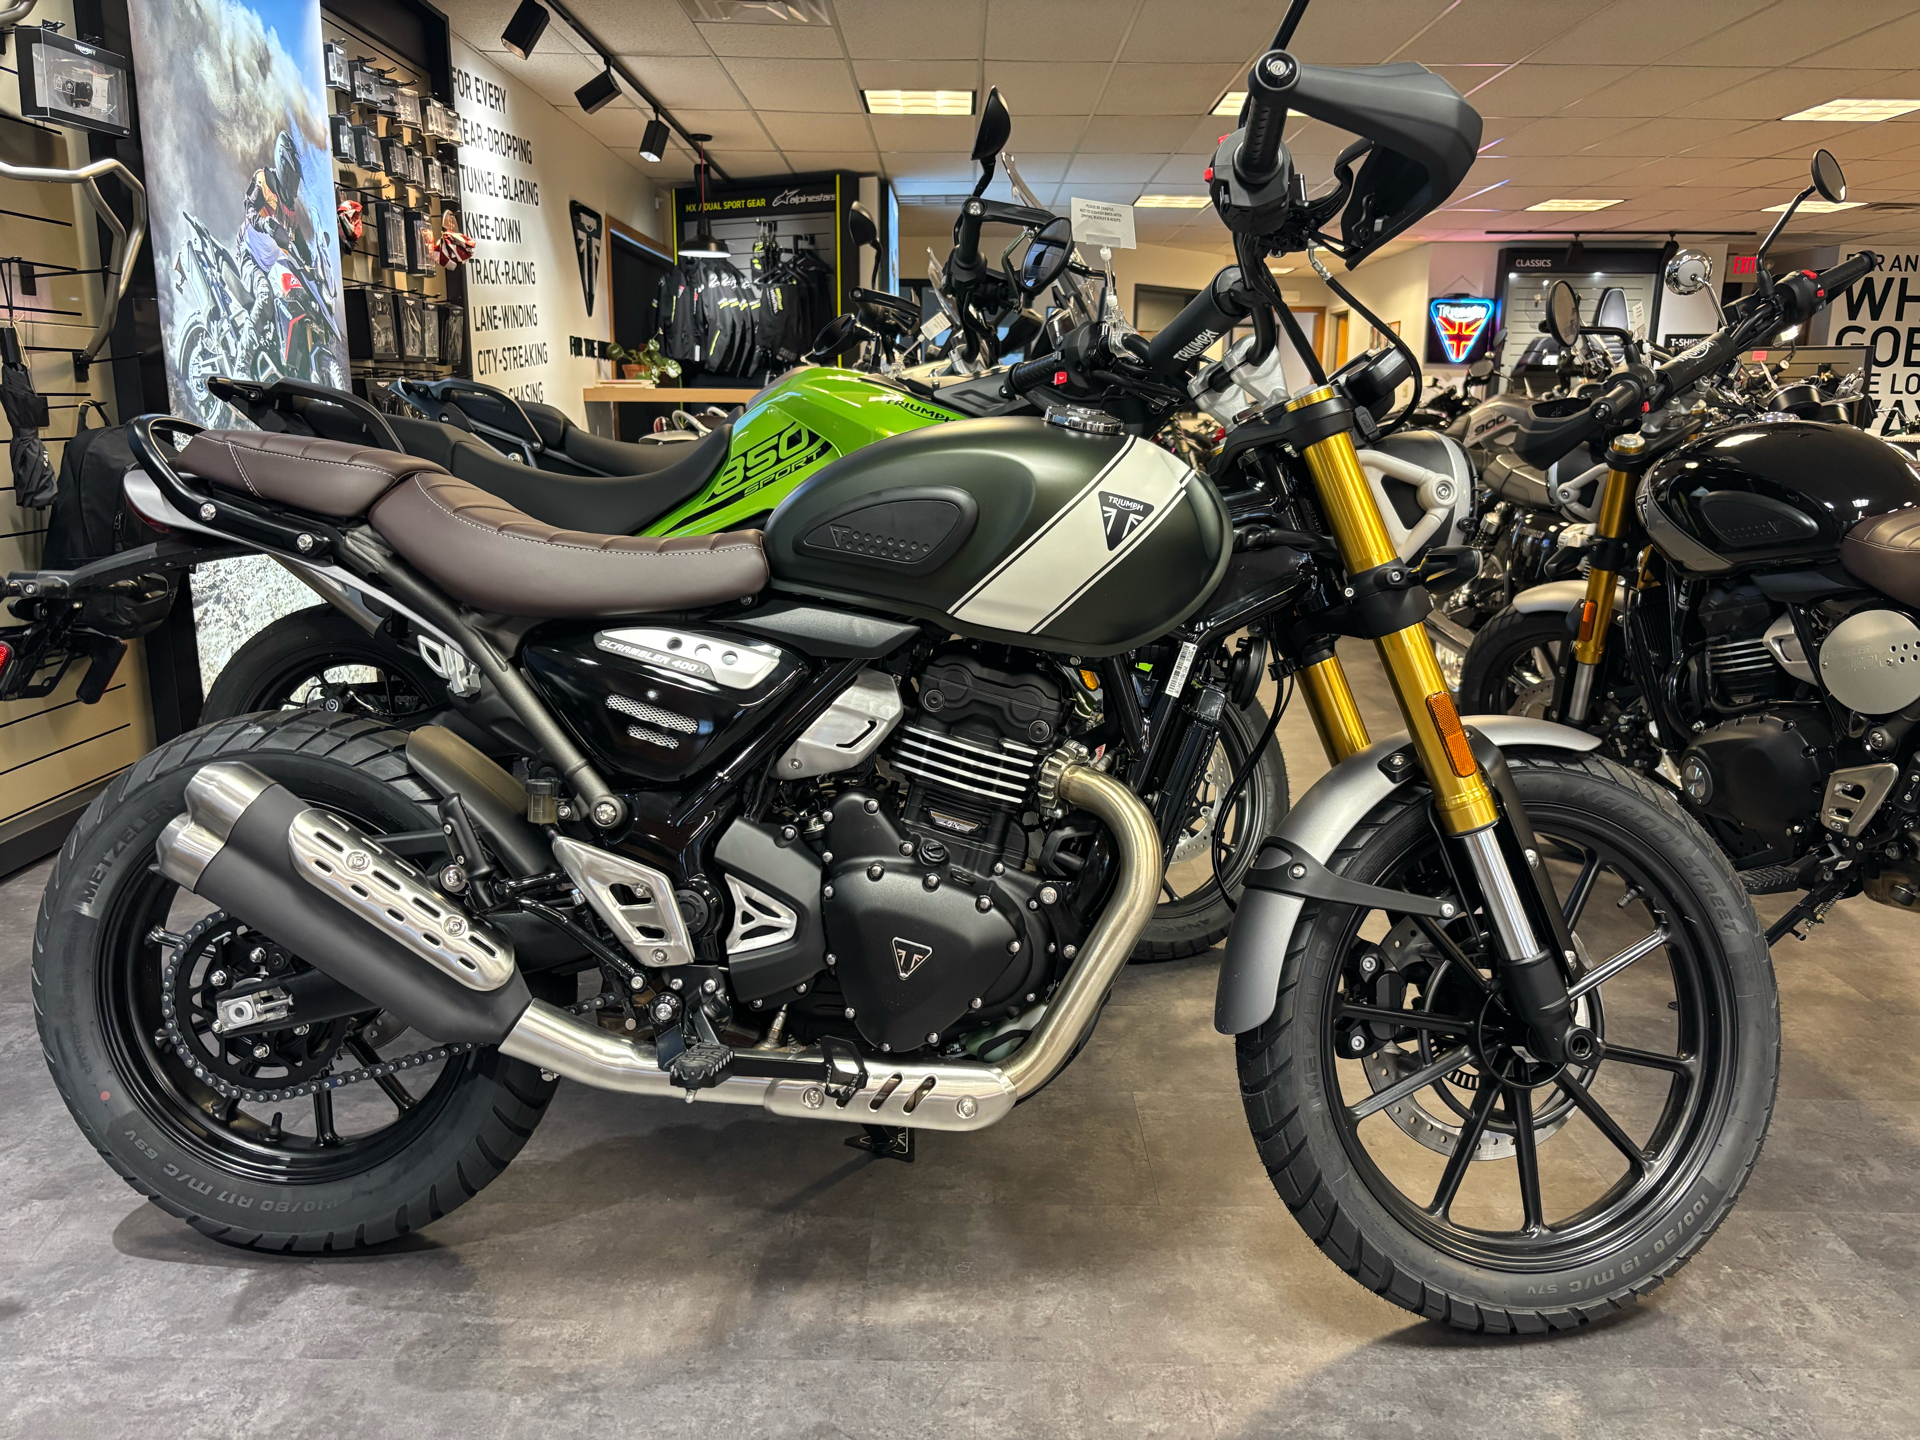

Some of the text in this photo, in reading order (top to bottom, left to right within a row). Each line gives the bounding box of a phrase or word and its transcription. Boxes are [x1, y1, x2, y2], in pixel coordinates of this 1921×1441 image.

[452, 66, 507, 115] FOR EVERY
[460, 117, 533, 165] EAR-DROPPING
[459, 164, 539, 207] TUNNEL-BLARING
[789, 193, 836, 206] alpinestars
[685, 204, 697, 213] MX
[704, 201, 722, 211] DUAL
[723, 200, 745, 210] SPORT
[747, 198, 766, 208] GEAR
[464, 211, 522, 244] KNEE-DOWN
[468, 258, 536, 285] TRACK-RACING
[1515, 259, 1552, 268] CLASSICS
[1733, 256, 1757, 274] EXIT
[473, 304, 538, 332] LANE-WINDING
[477, 342, 548, 376] CITY-STREAKING
[1173, 328, 1220, 362] TRIUMPH
[885, 398, 957, 423] TRIUMPH
[713, 421, 811, 496] 850
[744, 447, 823, 498] SPORT
[1108, 495, 1144, 512] TRIUMPH
[598, 638, 671, 665] SCRAMBLER
[78, 800, 178, 906] METZELER
[1678, 855, 1741, 935] STREET
[123, 1129, 158, 1161] 69V
[163, 1162, 214, 1196] M/C
[217, 1190, 255, 1209] R17
[1653, 1193, 1710, 1254] 100/90
[1621, 1255, 1642, 1276] 19
[1526, 1284, 1558, 1295] 57V
[1569, 1272, 1616, 1293] M/C
